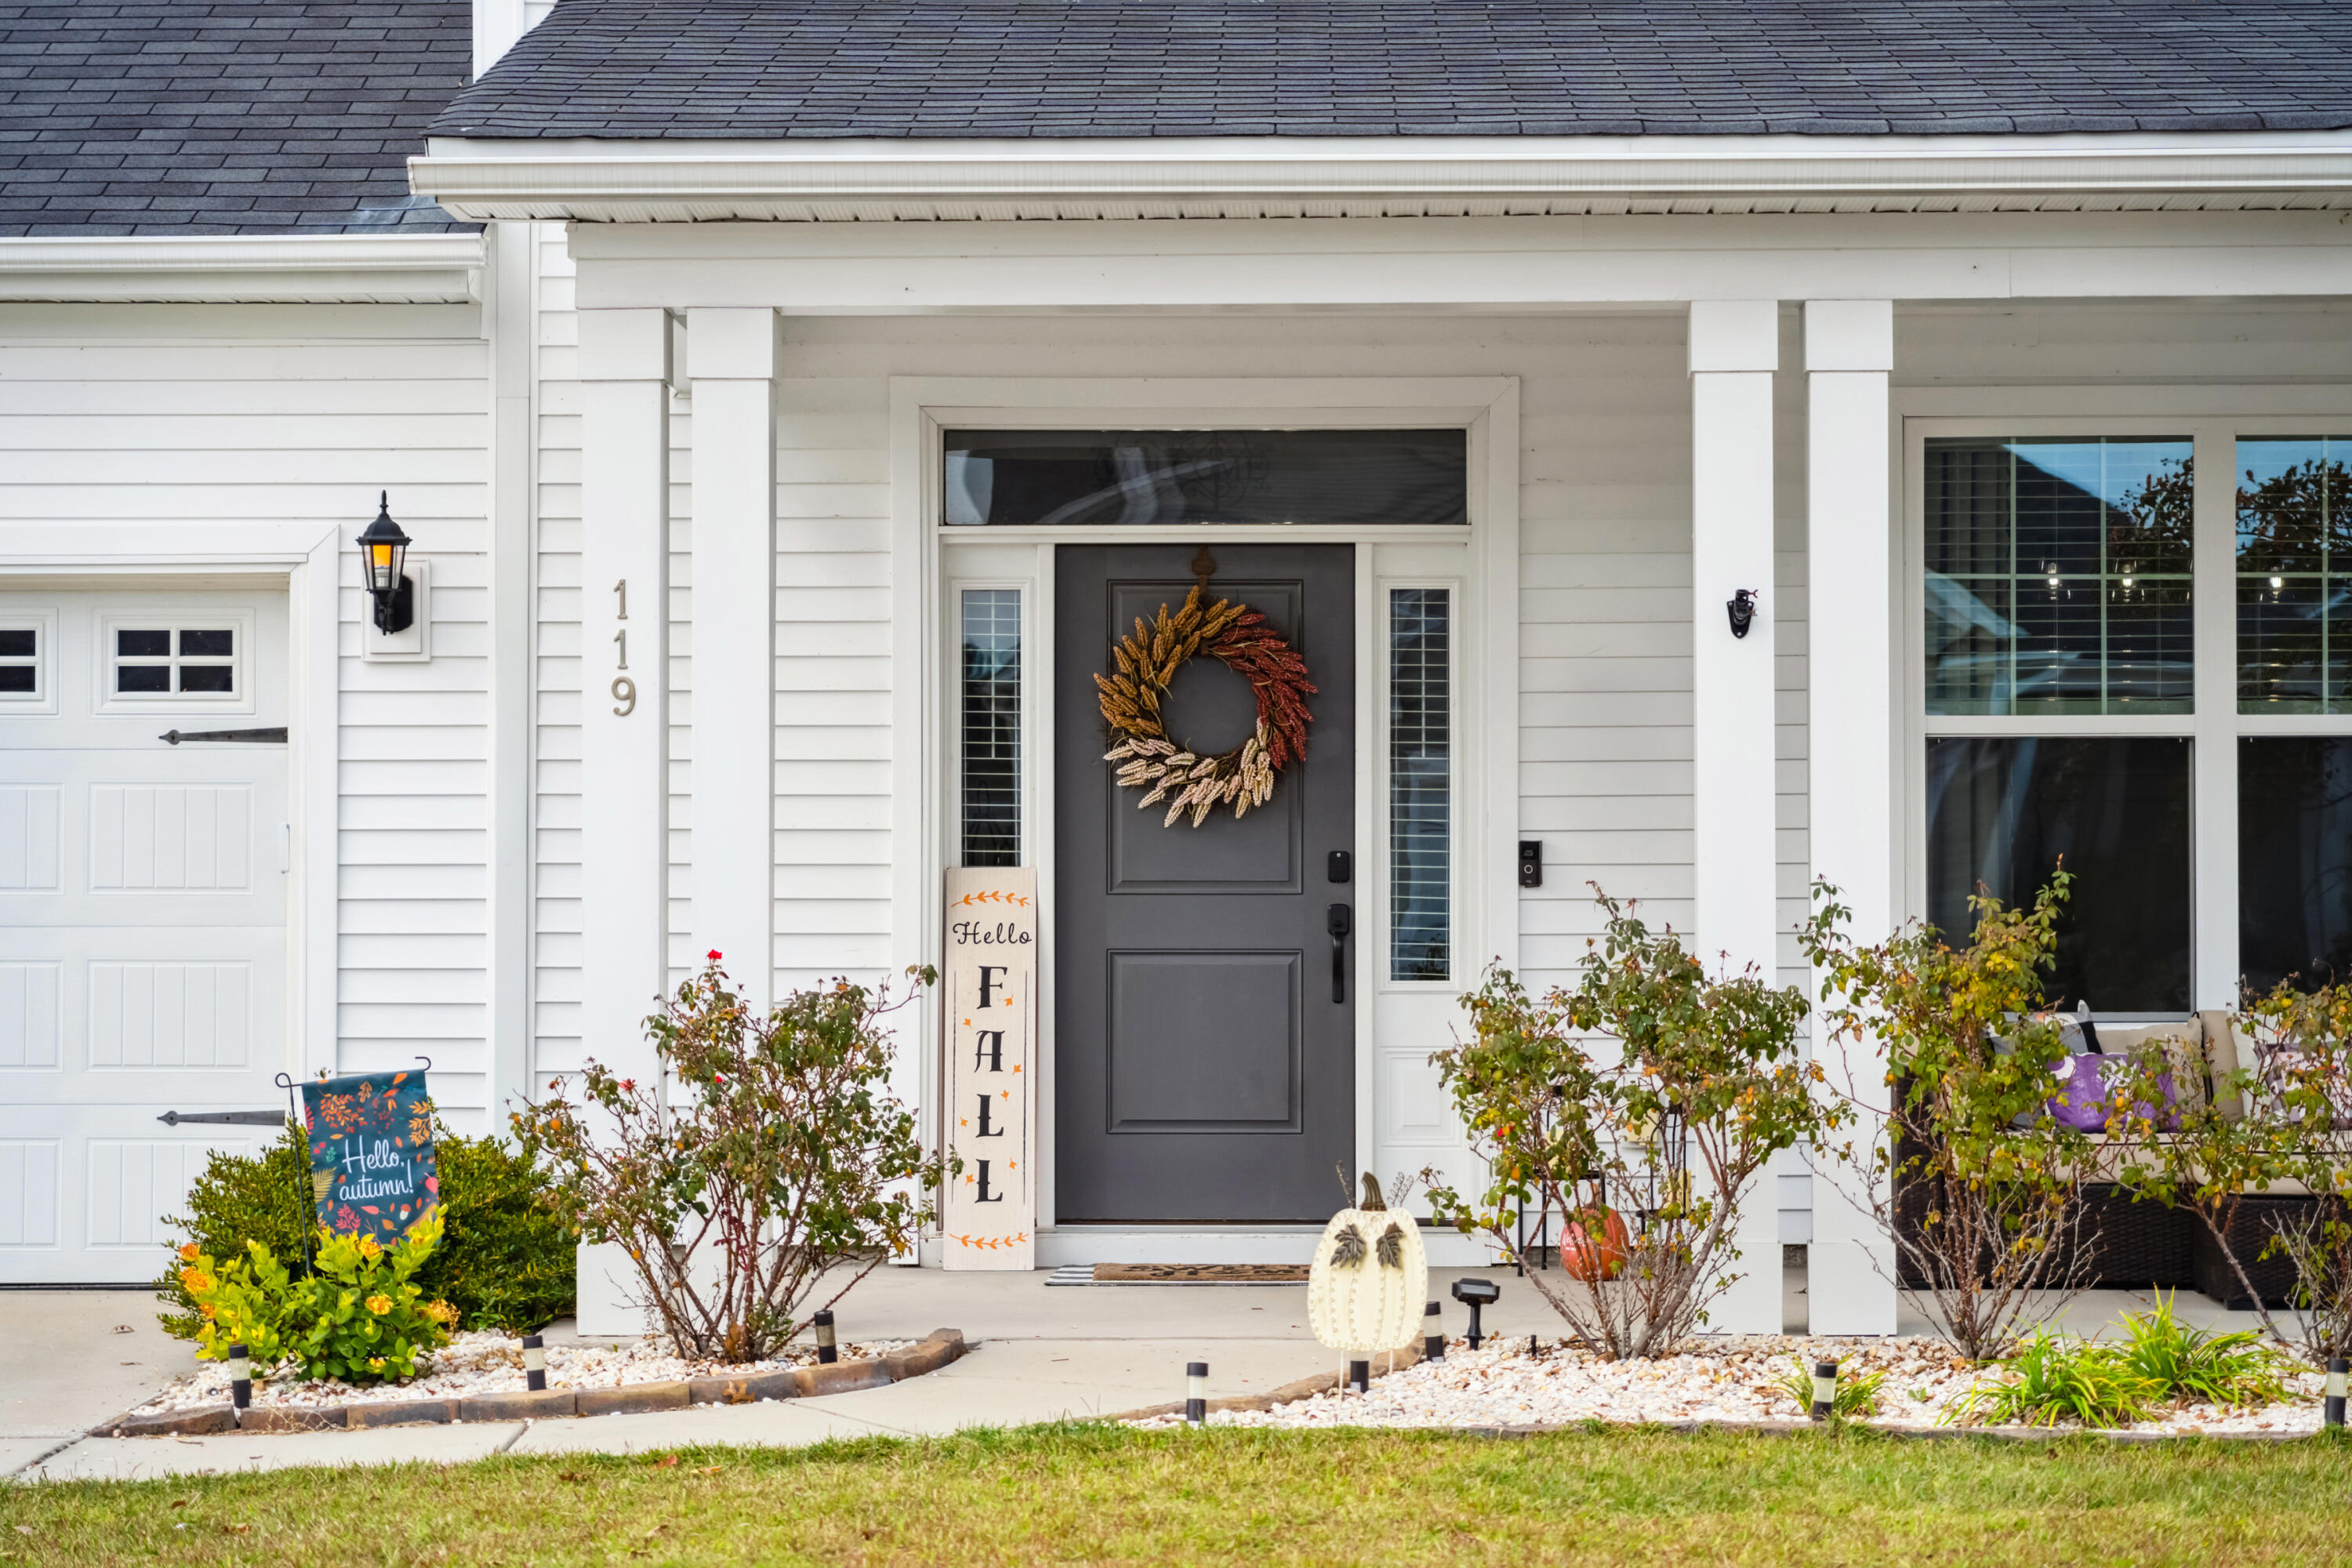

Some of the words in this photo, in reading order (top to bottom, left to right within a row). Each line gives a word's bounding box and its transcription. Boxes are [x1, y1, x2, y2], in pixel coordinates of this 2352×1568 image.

[612, 579, 637, 717] 119
[952, 921, 1033, 945] Hello
[975, 965, 1008, 1203] FALL
[339, 1159, 414, 1201] autumn!
